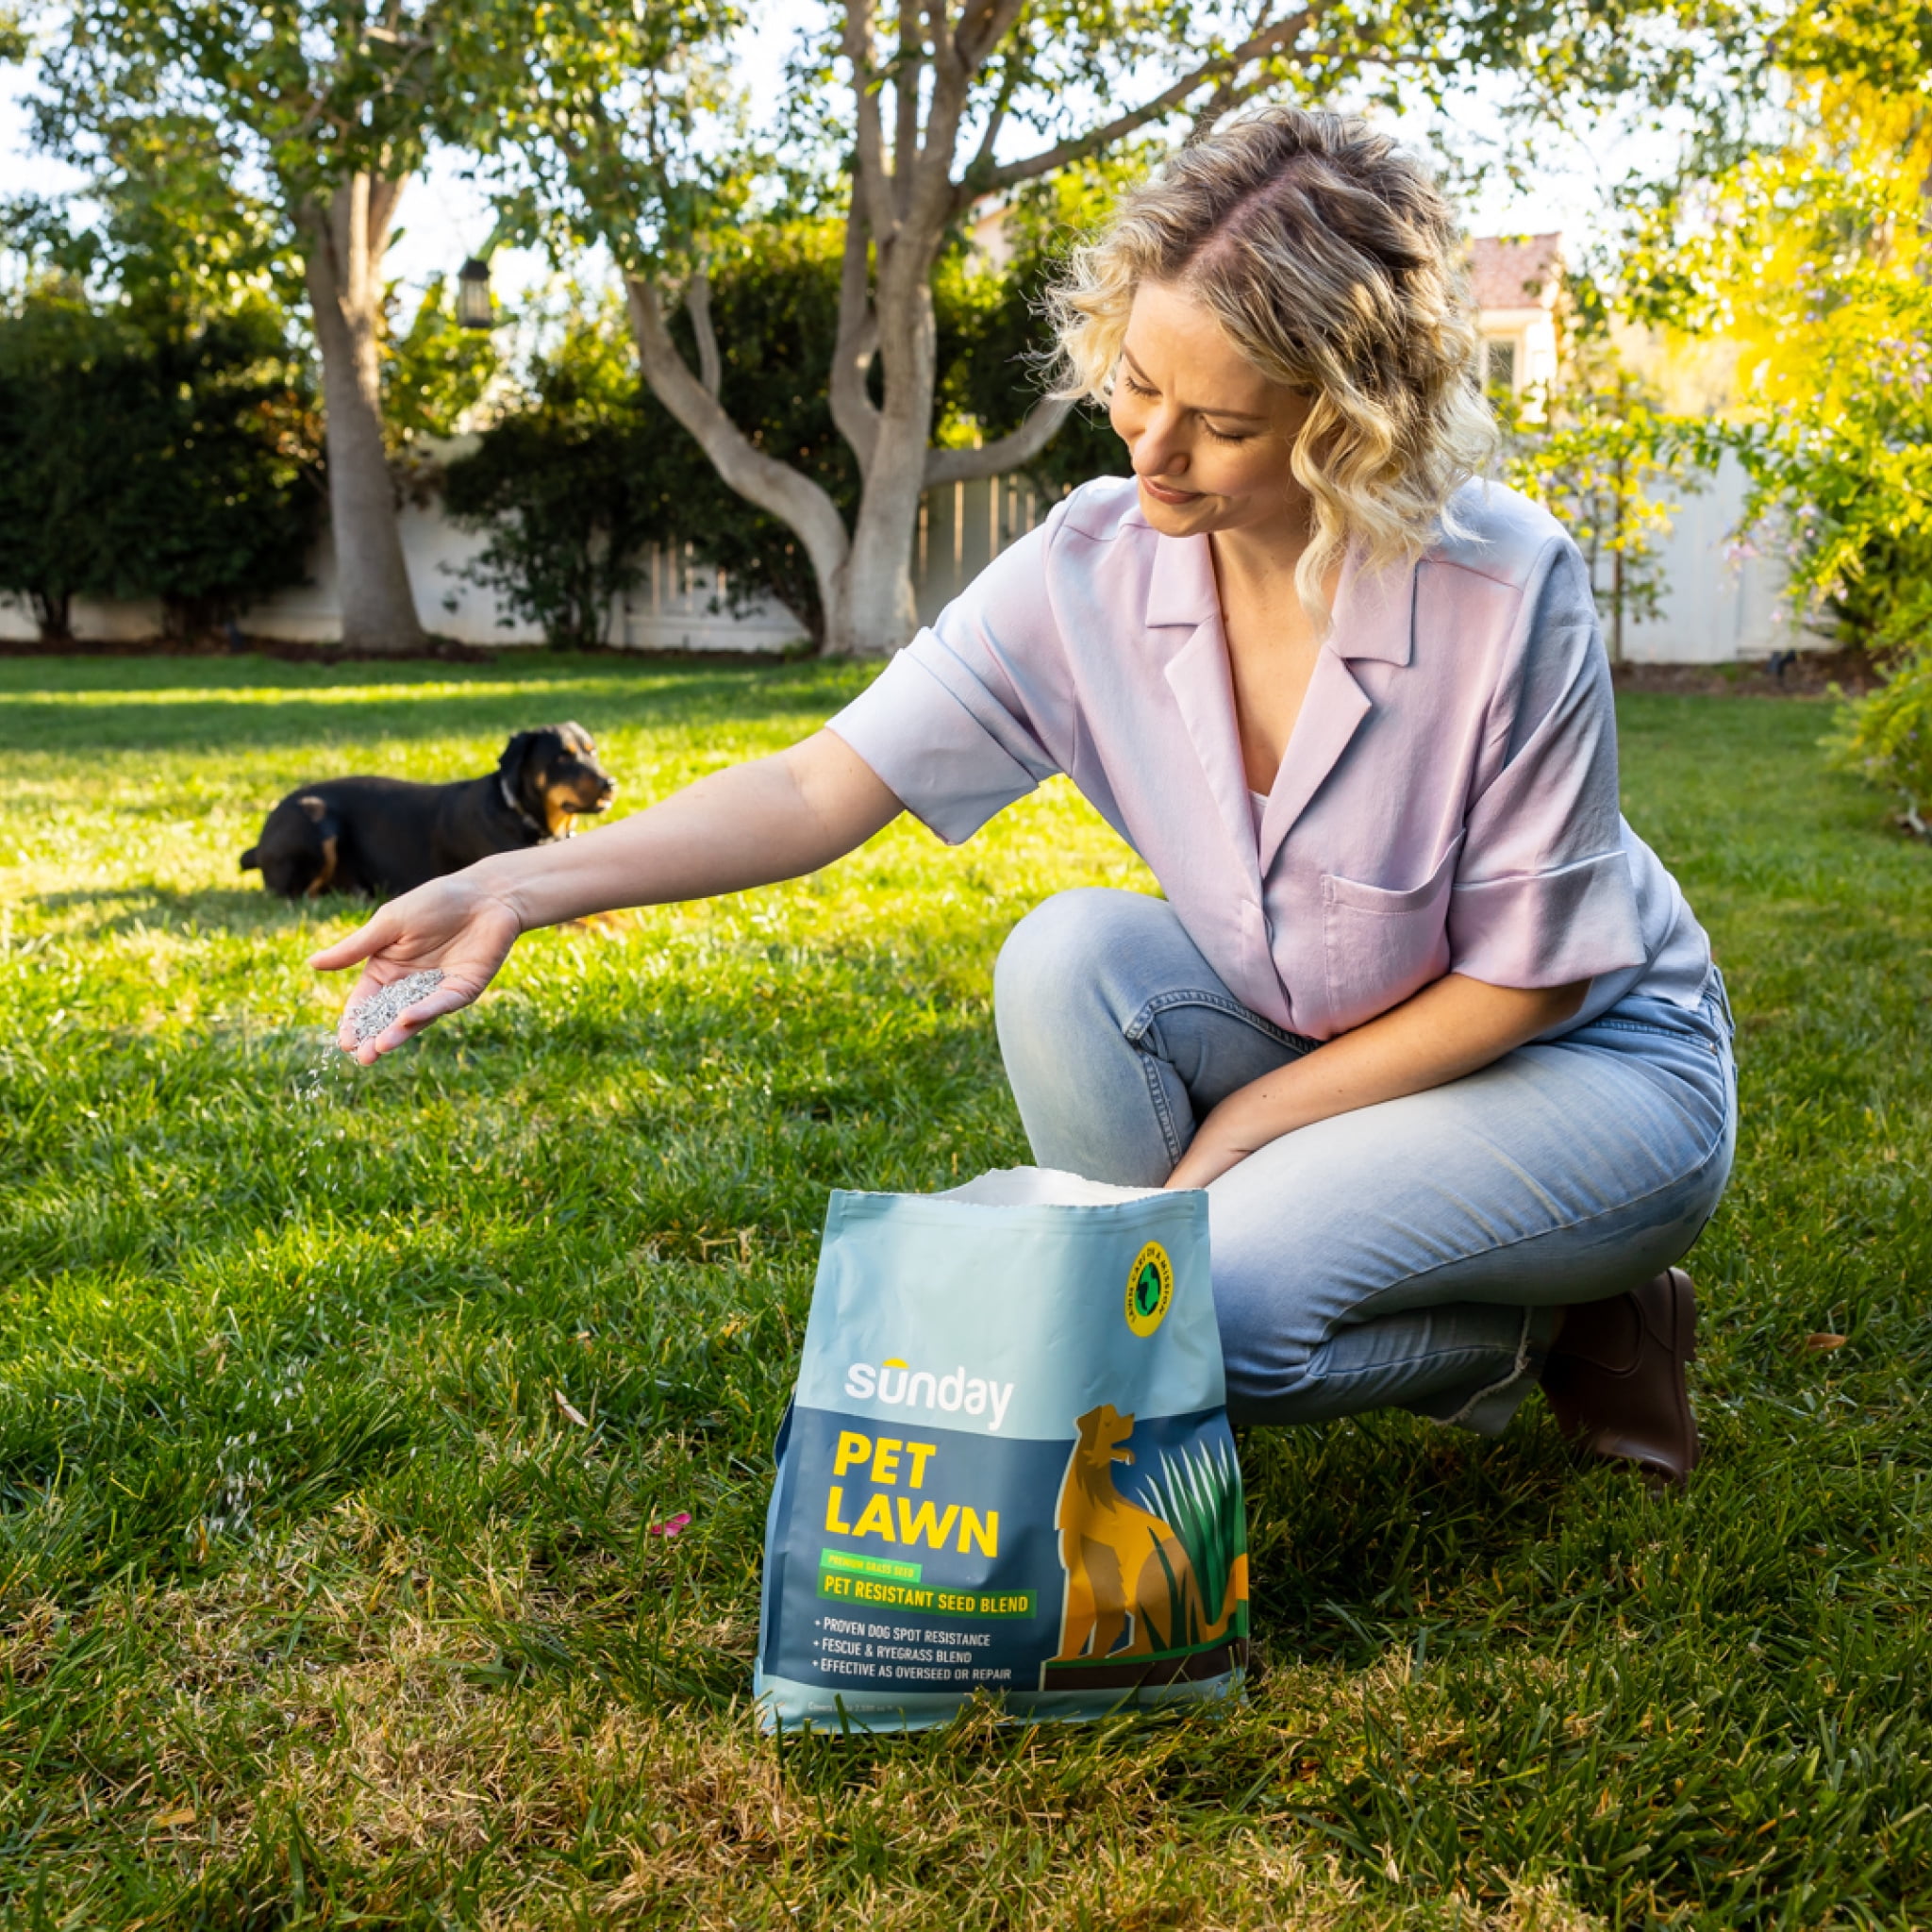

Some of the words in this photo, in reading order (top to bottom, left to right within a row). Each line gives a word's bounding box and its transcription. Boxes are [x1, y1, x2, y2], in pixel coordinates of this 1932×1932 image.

[844, 1357, 1014, 1431] sunday
[833, 1430, 937, 1490] PET
[824, 1486, 999, 1558] LAWN
[828, 1554, 864, 1571] PREMIUM
[866, 1560, 891, 1574] GRASS
[893, 1565, 914, 1579] SEED
[824, 1575, 851, 1595] PET
[855, 1581, 934, 1608] RESISTANT
[938, 1592, 975, 1612] SEED
[980, 1596, 1028, 1613] BLEND
[824, 1616, 865, 1636] PROVEN
[868, 1624, 891, 1640] DOG
[892, 1627, 922, 1642] SPOT
[924, 1630, 991, 1647] RESISTANCE
[822, 1638, 861, 1656] FESCUE
[864, 1643, 874, 1658] &
[876, 1644, 933, 1661] RYEGRASS
[936, 1649, 973, 1663] BLEND
[821, 1657, 875, 1676] EFFECTIVE
[878, 1665, 892, 1678] AS
[895, 1666, 951, 1681] OVERSEED
[954, 1669, 970, 1680] OR
[972, 1669, 1012, 1680] REPAIR
